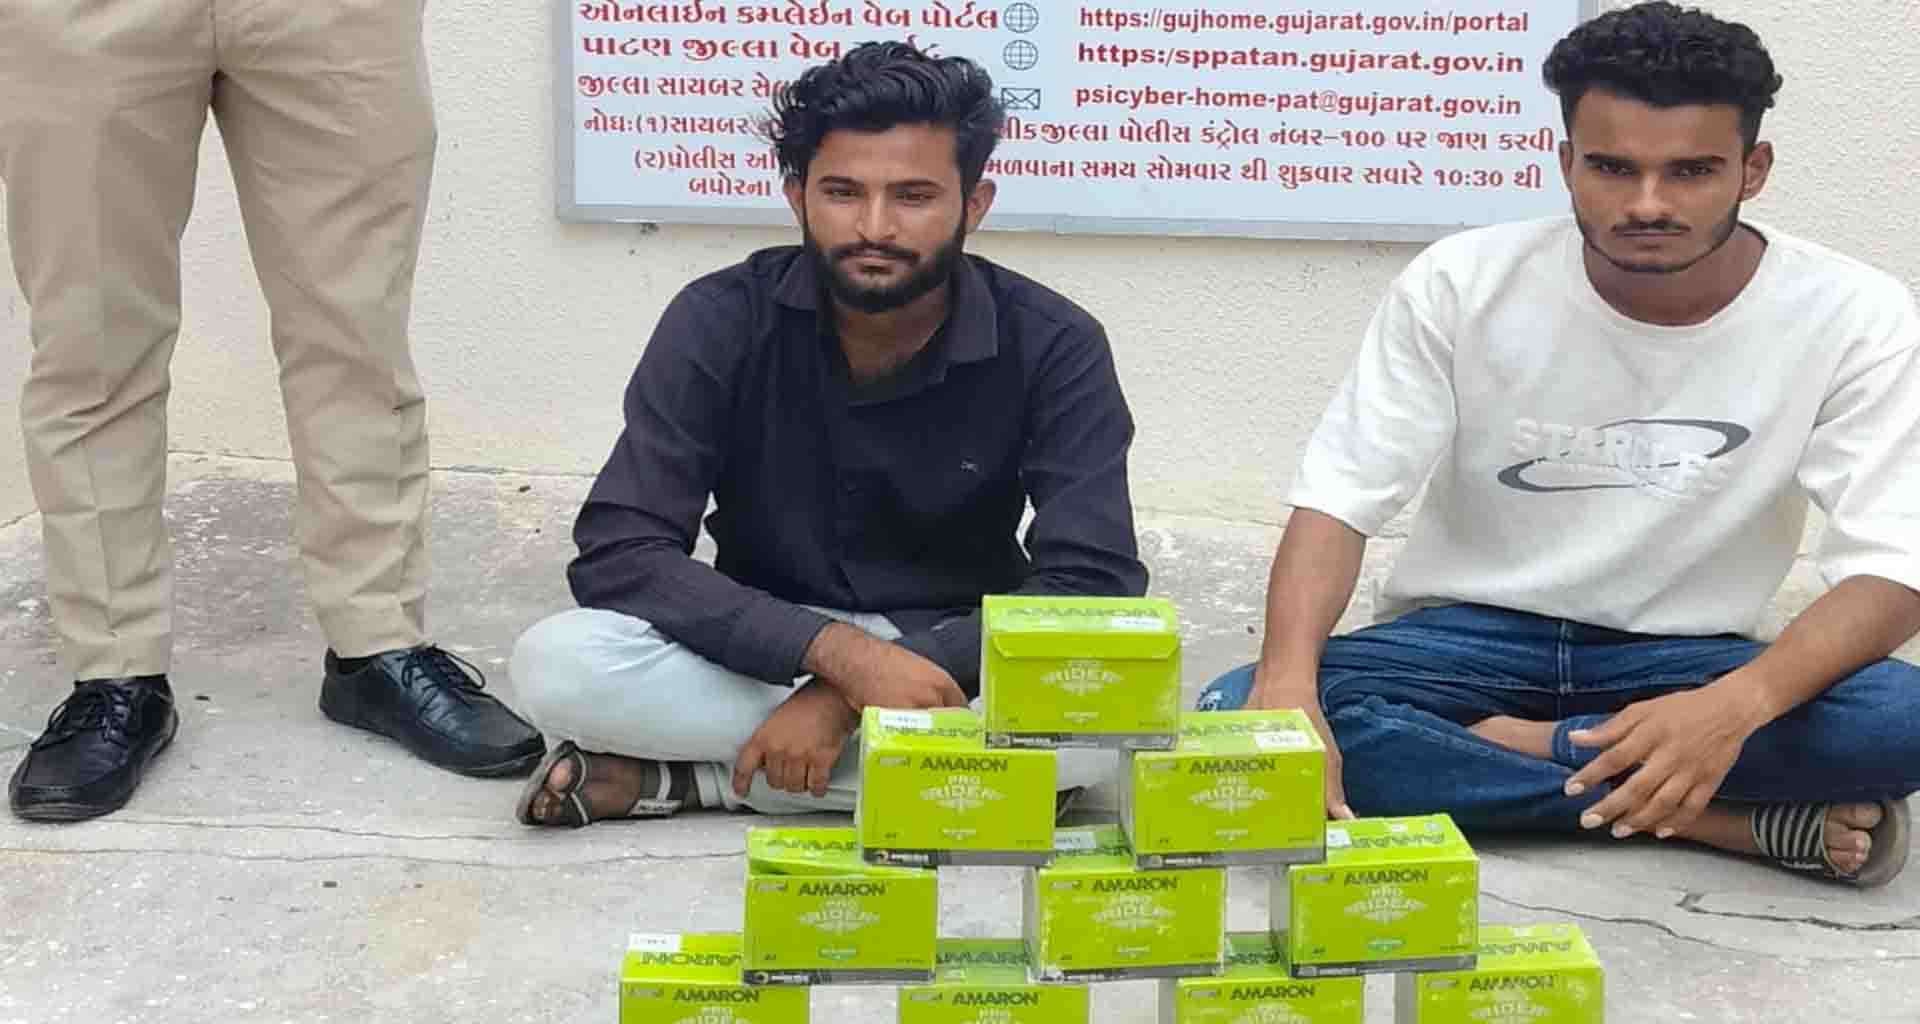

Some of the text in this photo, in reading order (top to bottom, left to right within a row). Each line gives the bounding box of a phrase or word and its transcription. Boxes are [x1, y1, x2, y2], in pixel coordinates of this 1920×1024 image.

[863, 0, 910, 27] વેબ
[922, 0, 998, 29] પોર્ટલ
[1080, 7, 1529, 36] https://gujhome.gujarat.gov.in/portal
[583, 37, 671, 57] પાટણ
[682, 39, 778, 62] જીલ્લા
[1078, 42, 1524, 76] https:/sppatan.gujarat.gov.in
[578, 75, 650, 98] જીલ્લા
[657, 77, 744, 97] સાયબર
[1076, 84, 1521, 118] psicyber-home-pat@gujarat.gov.in
[1119, 117, 1190, 143] પોલીસ
[1202, 119, 1259, 147] કંટ્રોલ
[1396, 131, 1427, 149] પર
[1437, 132, 1487, 151] જાણ
[1499, 127, 1554, 152] કરવી
[688, 167, 771, 197] બપોરના
[1081, 161, 1136, 179] સમય
[1146, 154, 1231, 181] સોમવાર
[1241, 157, 1267, 182] થી
[1363, 159, 1423, 185] સવારે
[1513, 163, 1541, 189] થી
[920, 757, 1008, 773] AMARON
[1189, 757, 1277, 776] AMARON
[798, 880, 887, 897] AMARON
[1092, 876, 1178, 893] AMARON
[1344, 868, 1430, 886] AMARON
[673, 988, 760, 1004] AMARON
[951, 992, 1040, 1007] AMARON
[1230, 984, 1317, 1001] AMARON
